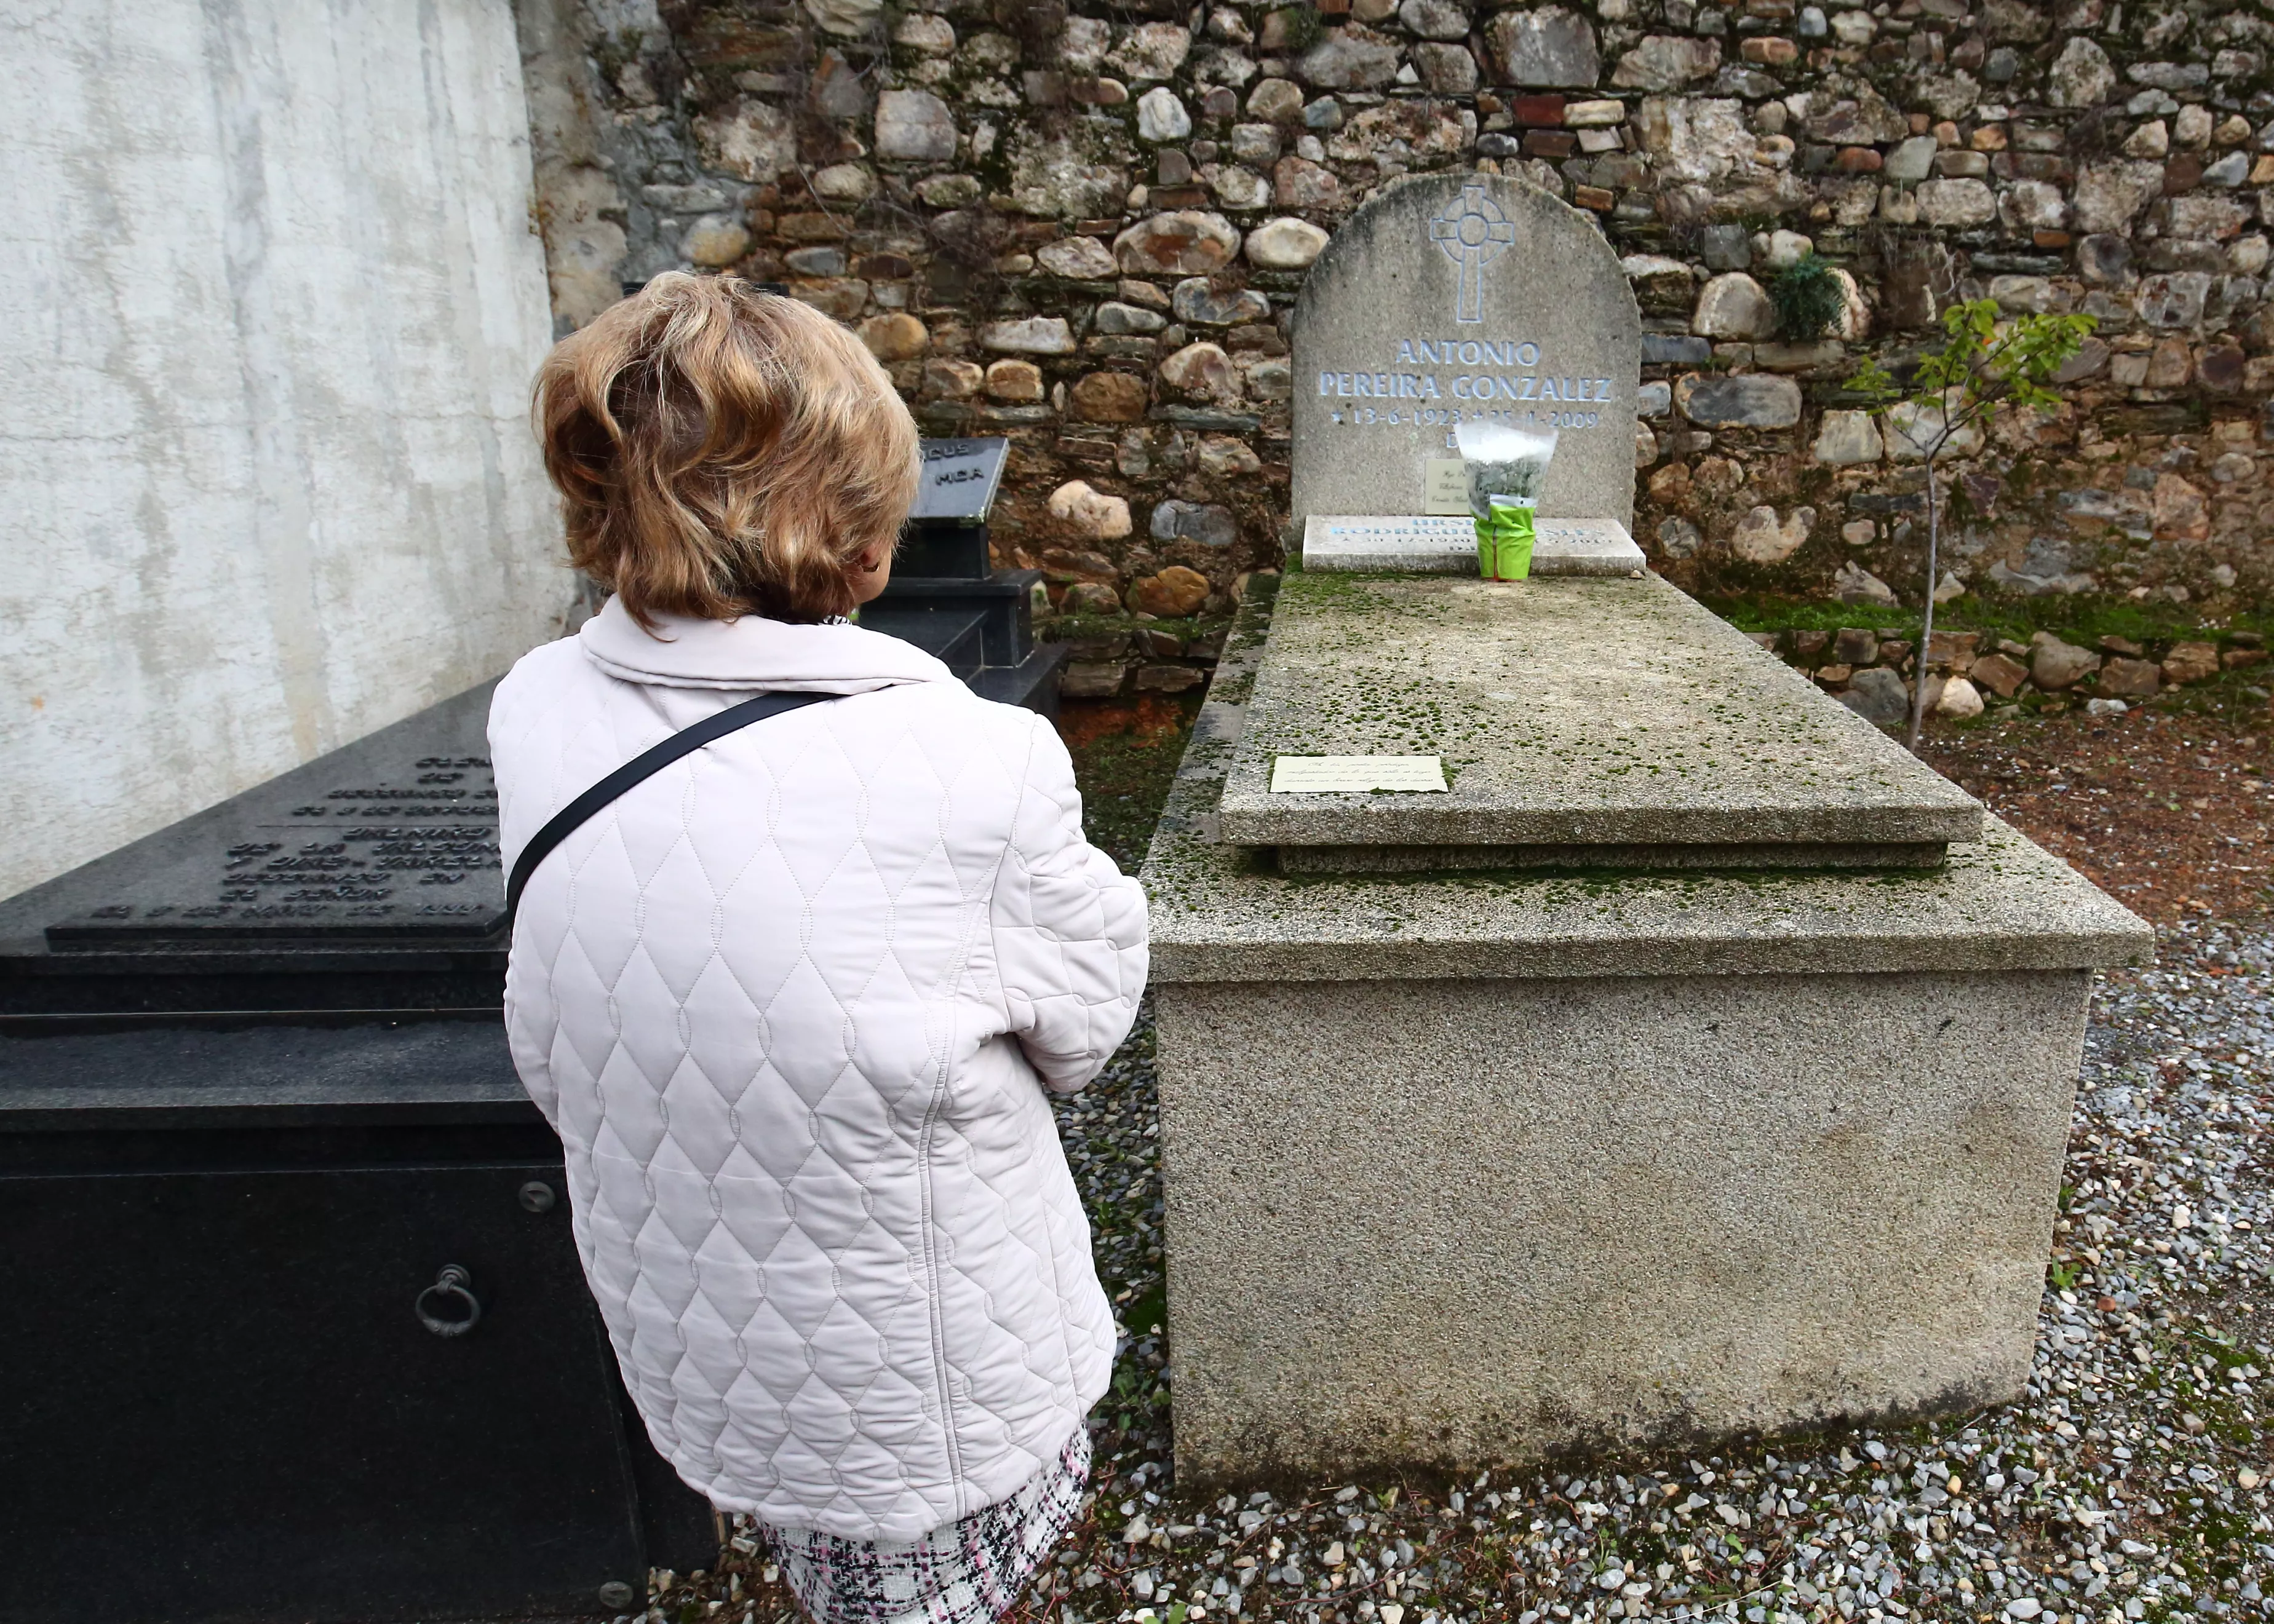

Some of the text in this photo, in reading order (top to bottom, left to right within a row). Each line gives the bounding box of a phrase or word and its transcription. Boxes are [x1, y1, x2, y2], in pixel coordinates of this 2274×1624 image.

[1396, 339, 1541, 367] ANTONIO
[1320, 371, 1613, 403] PEREIRA GONZALEZ
[1354, 407, 1463, 426] 13-6-1923
[921, 442, 970, 462] CUS
